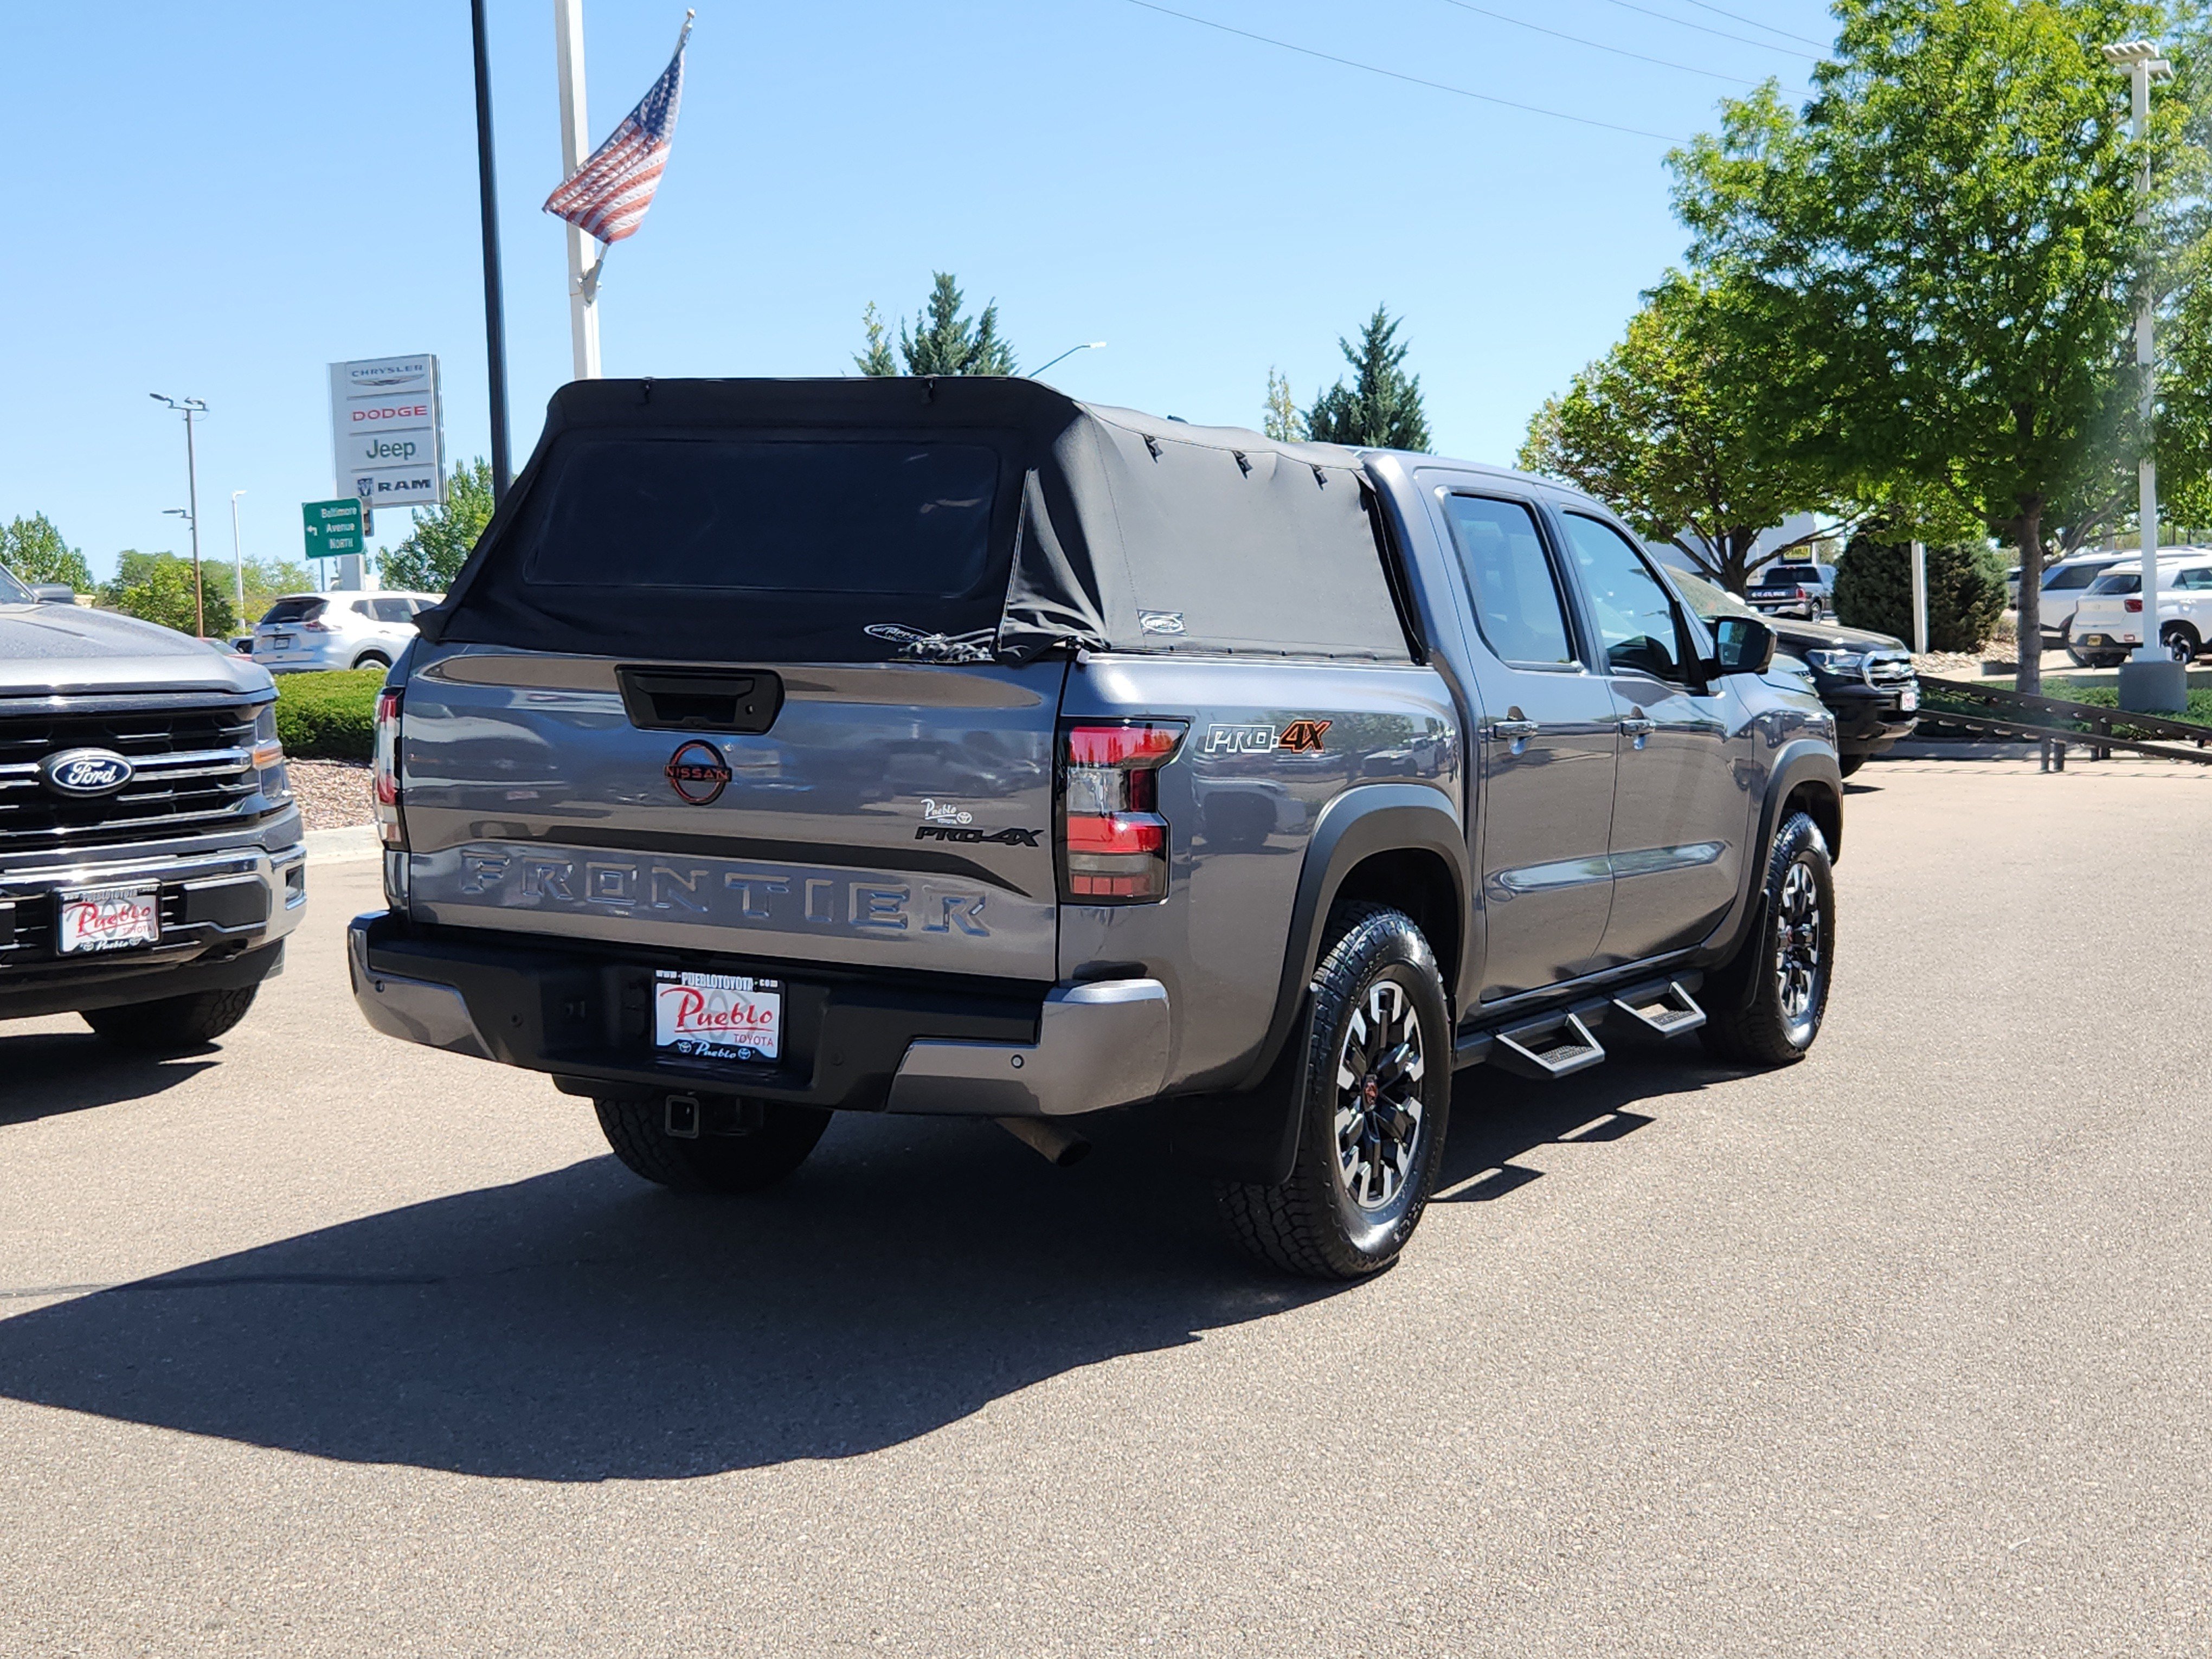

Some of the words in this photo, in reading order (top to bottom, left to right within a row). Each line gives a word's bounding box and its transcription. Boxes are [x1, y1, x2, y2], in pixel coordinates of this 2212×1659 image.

[351, 364, 423, 377] CHRYSLER
[352, 405, 428, 422] DODGE
[366, 439, 416, 460] Jeep
[378, 479, 432, 492] RAM
[326, 523, 355, 533] Avenue
[68, 761, 117, 785] Ford
[665, 765, 729, 780] NISSAN
[921, 799, 957, 817] Pueblo
[460, 851, 990, 937] FRONTIER
[63, 902, 151, 934] Pueblo
[660, 987, 773, 1028] Pueblo
[734, 1033, 774, 1047] TOYOTA
[692, 1040, 737, 1059] Pueblo
